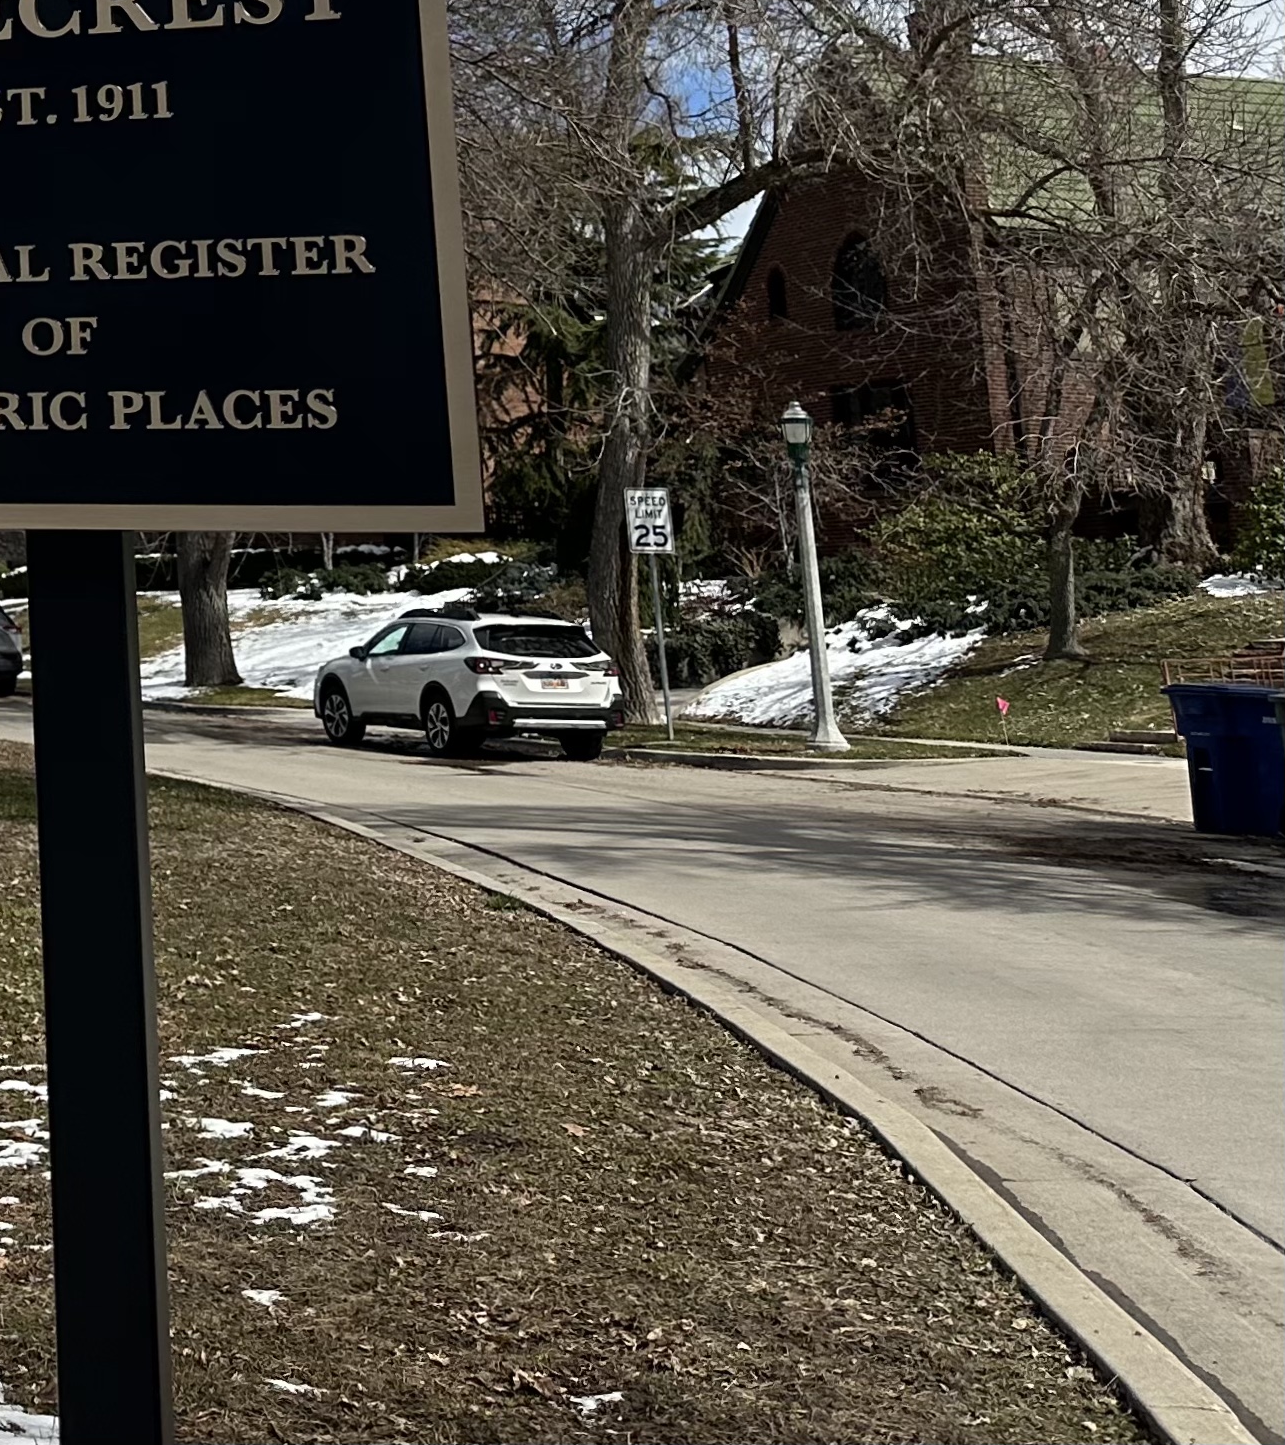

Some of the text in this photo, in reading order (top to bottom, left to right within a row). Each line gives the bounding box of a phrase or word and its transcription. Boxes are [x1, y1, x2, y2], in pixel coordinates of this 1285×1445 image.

[72, 80, 174, 123] 1911
[69, 234, 376, 281] REGISTER
[21, 316, 98, 356] OF
[107, 388, 338, 430] PLACES
[630, 496, 666, 507] SPEED
[635, 509, 662, 519] LIMIT
[634, 524, 668, 547] 25
